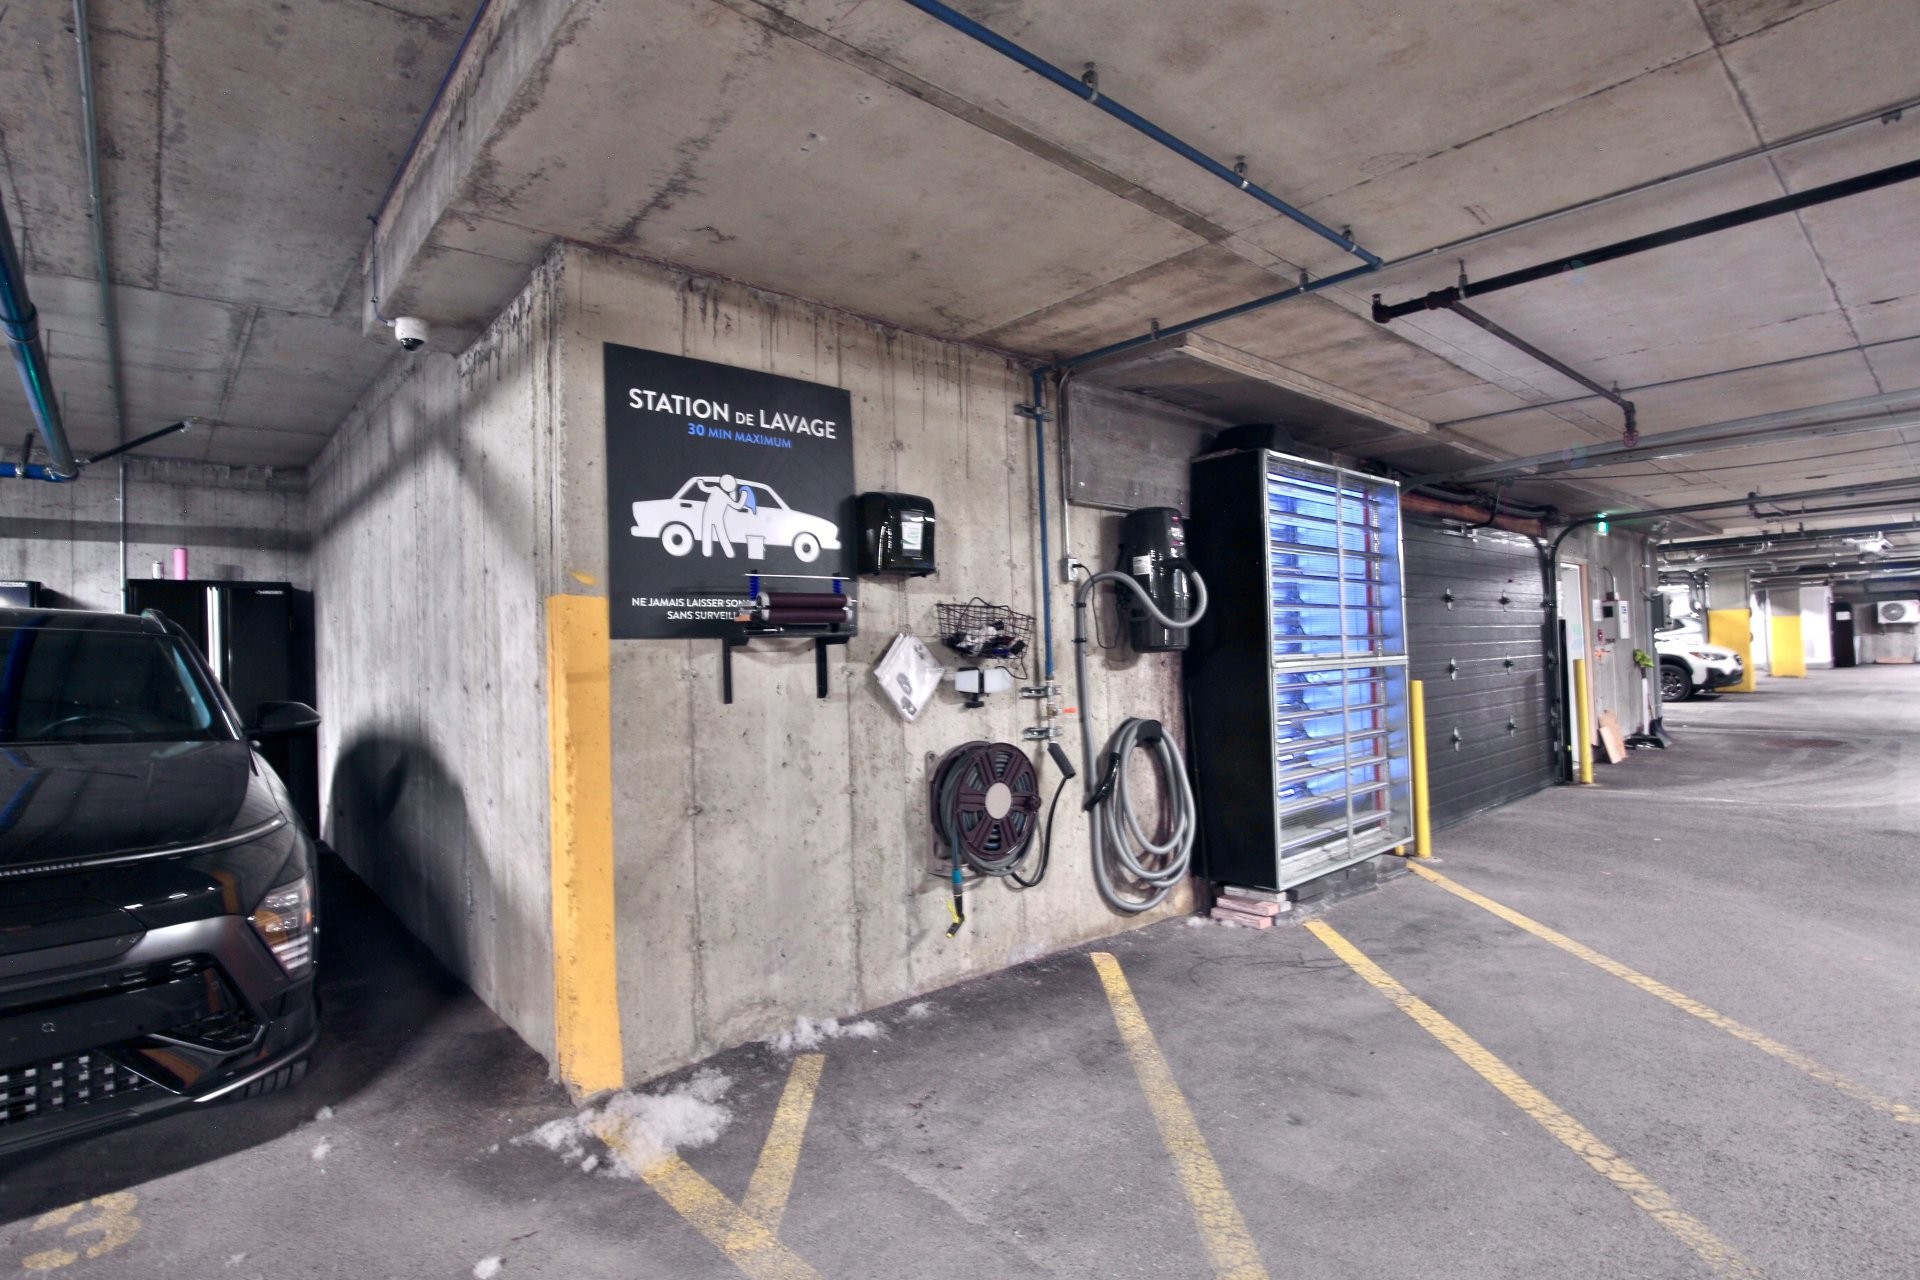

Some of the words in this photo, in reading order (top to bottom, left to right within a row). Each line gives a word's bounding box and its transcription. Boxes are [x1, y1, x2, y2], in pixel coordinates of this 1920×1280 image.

[628, 388, 730, 422] STATION
[735, 411, 755, 426] DE
[759, 409, 837, 439] LAVAGE
[687, 422, 705, 437] 30
[708, 427, 732, 441] MIN
[734, 431, 792, 449] MAXIMUM
[631, 598, 648, 606] NE
[648, 598, 684, 607] JAMAIS
[686, 599, 724, 607] LAISSER
[667, 610, 693, 620] SANS
